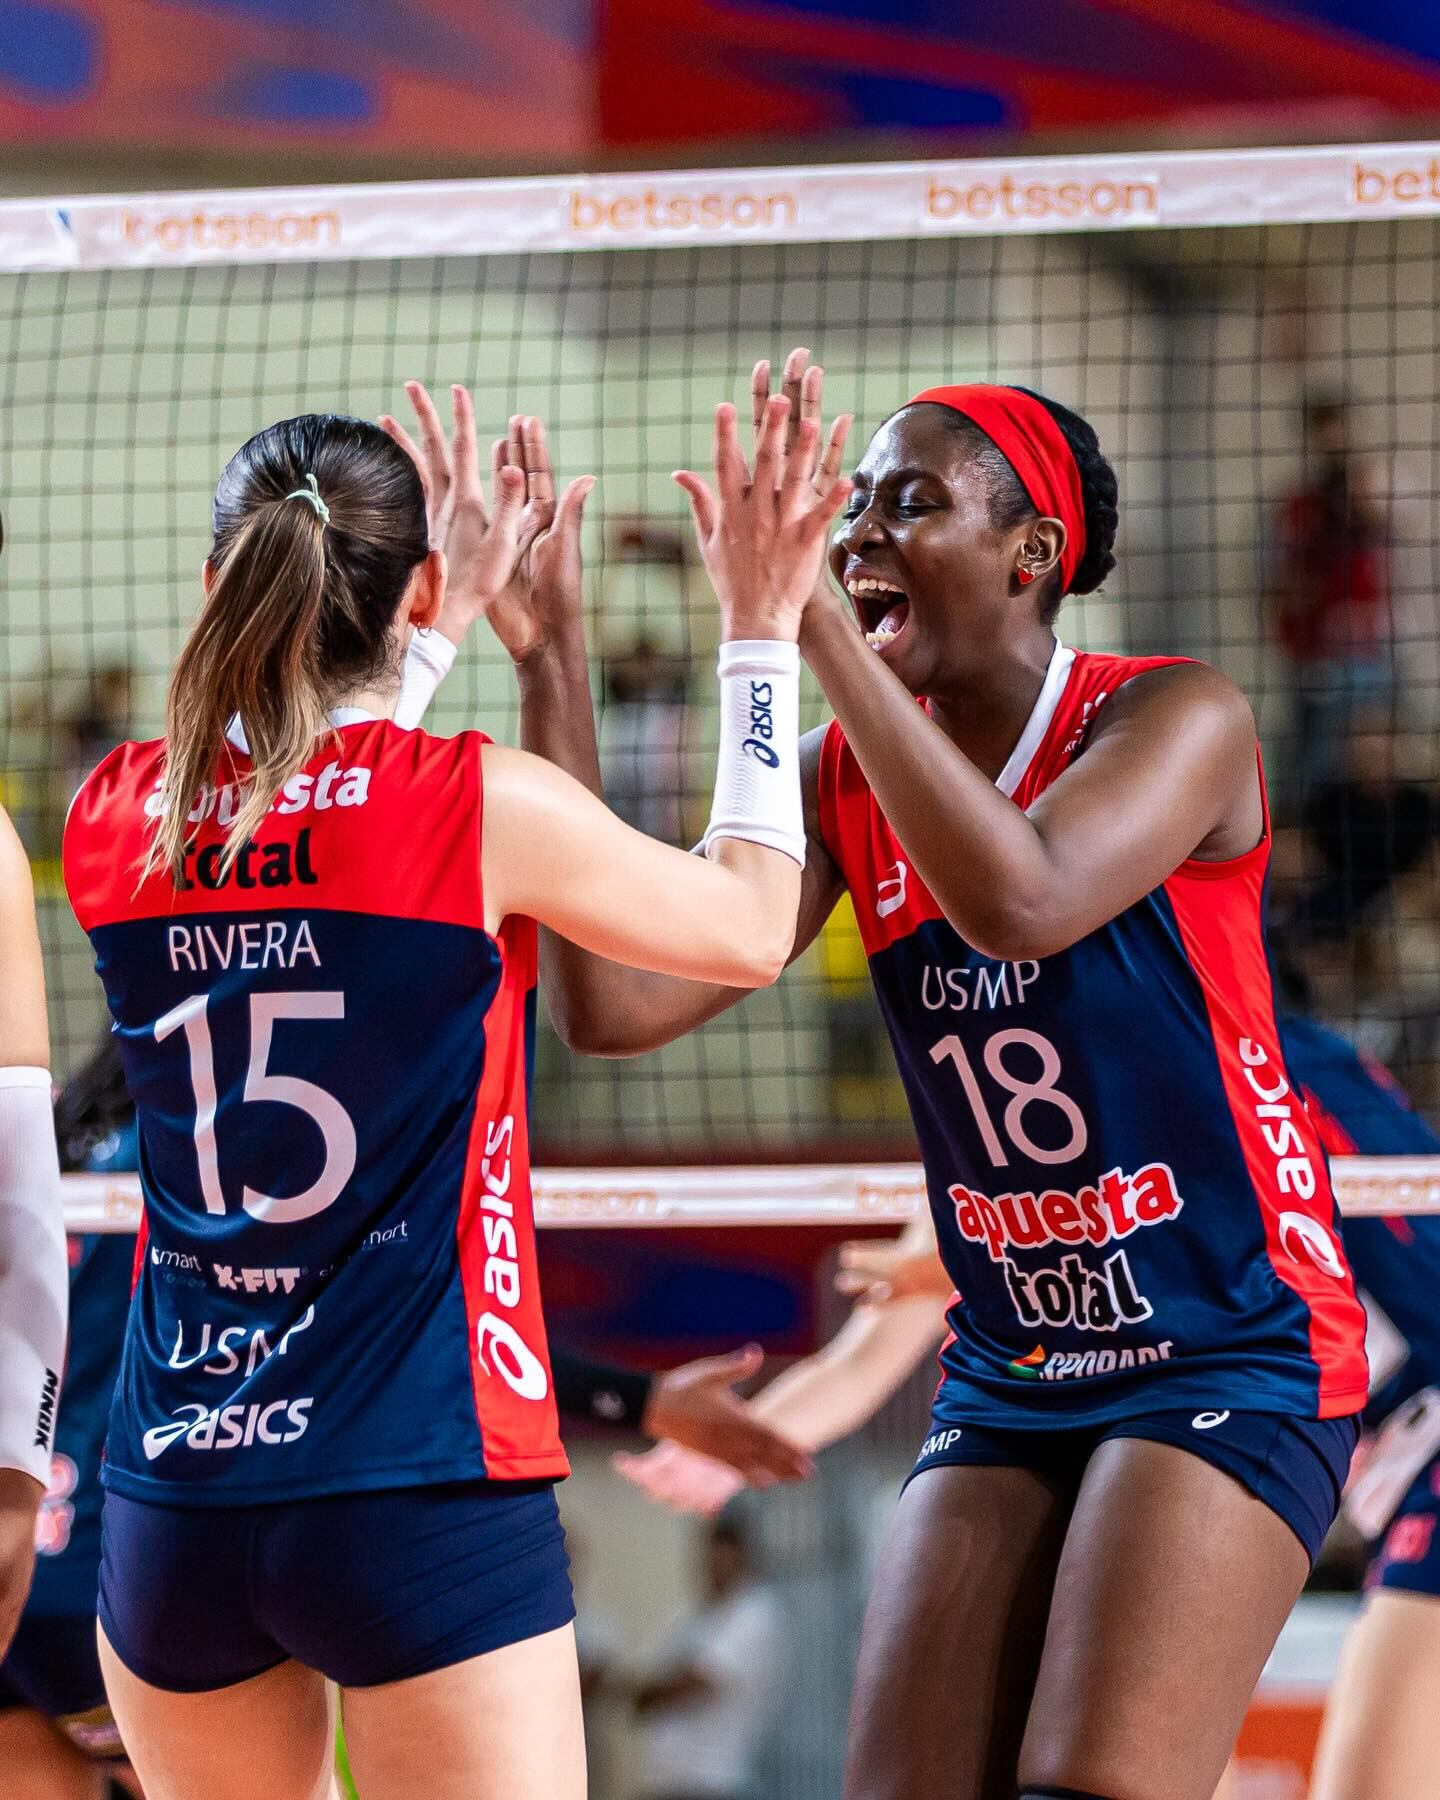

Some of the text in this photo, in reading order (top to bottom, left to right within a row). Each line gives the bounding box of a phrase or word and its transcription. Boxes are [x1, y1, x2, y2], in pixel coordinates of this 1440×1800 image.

[570, 186, 798, 231] betsson
[926, 174, 1156, 219] betsson
[750, 680, 773, 740] asics
[173, 827, 318, 891] total
[168, 920, 321, 972] RIVERA
[921, 960, 1040, 1011] USMP
[154, 990, 357, 1223] 15
[928, 1028, 1088, 1167] 18
[1239, 1037, 1316, 1200] asics
[480, 1115, 521, 1308] asics
[948, 1163, 1184, 1262] apuesta
[213, 1263, 301, 1294] X-FIT
[1003, 1249, 1154, 1332] total
[187, 1397, 314, 1450] asics
